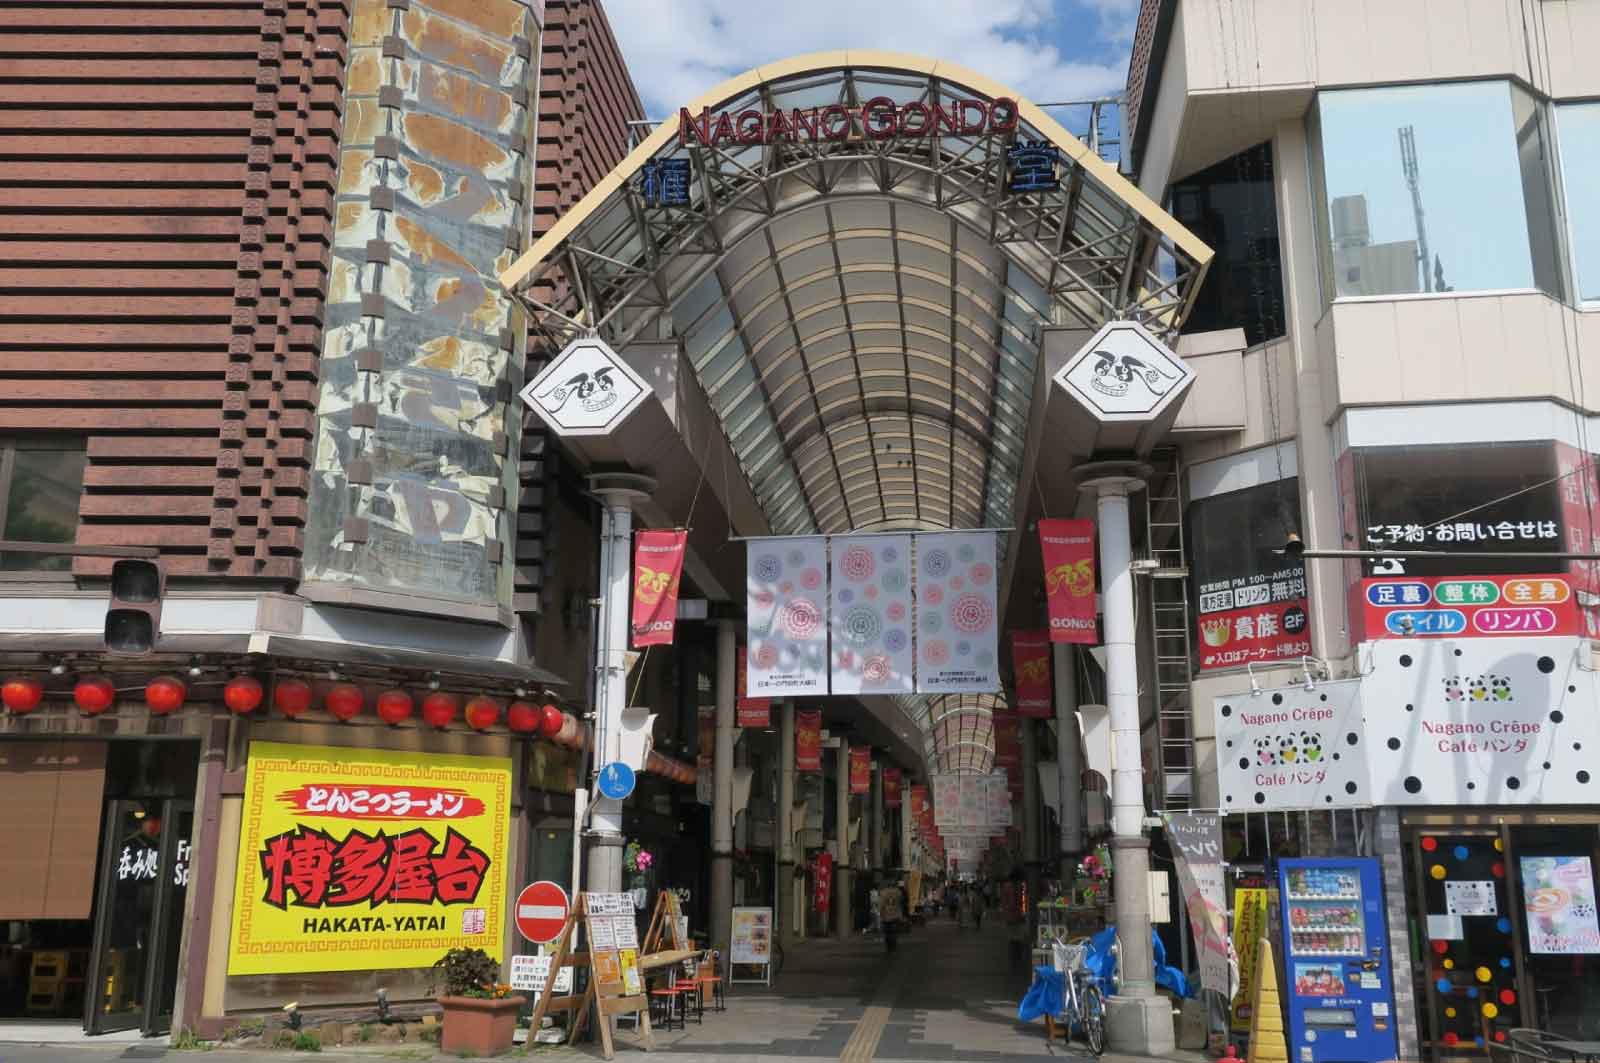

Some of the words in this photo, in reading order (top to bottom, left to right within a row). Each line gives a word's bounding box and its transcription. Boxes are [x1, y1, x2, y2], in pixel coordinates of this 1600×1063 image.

[678, 104, 850, 147] NAGANO
[862, 97, 1020, 139] GONDO
[1367, 521, 1558, 543] ご予約・お問い合せは
[1232, 578, 1246, 588] PM
[1237, 586, 1268, 606] ドリンク
[1271, 578, 1306, 601] 無料
[1377, 585, 1421, 603] 足裏
[1444, 583, 1489, 601] 整体
[1513, 582, 1558, 601] 全身
[1050, 617, 1096, 629] GONDO
[1235, 612, 1279, 641] 貴族
[1284, 613, 1305, 629] 2F
[1240, 713, 1288, 726] Nagano
[1292, 707, 1334, 722] Crêpe
[1422, 720, 1485, 735] Nagano
[1490, 720, 1541, 734] Crêpe
[305, 787, 464, 816] とんこつラーメン
[117, 845, 158, 880] 呑み処
[260, 825, 491, 911] 博多屋台
[303, 916, 446, 933] HAKATA-YATAI
